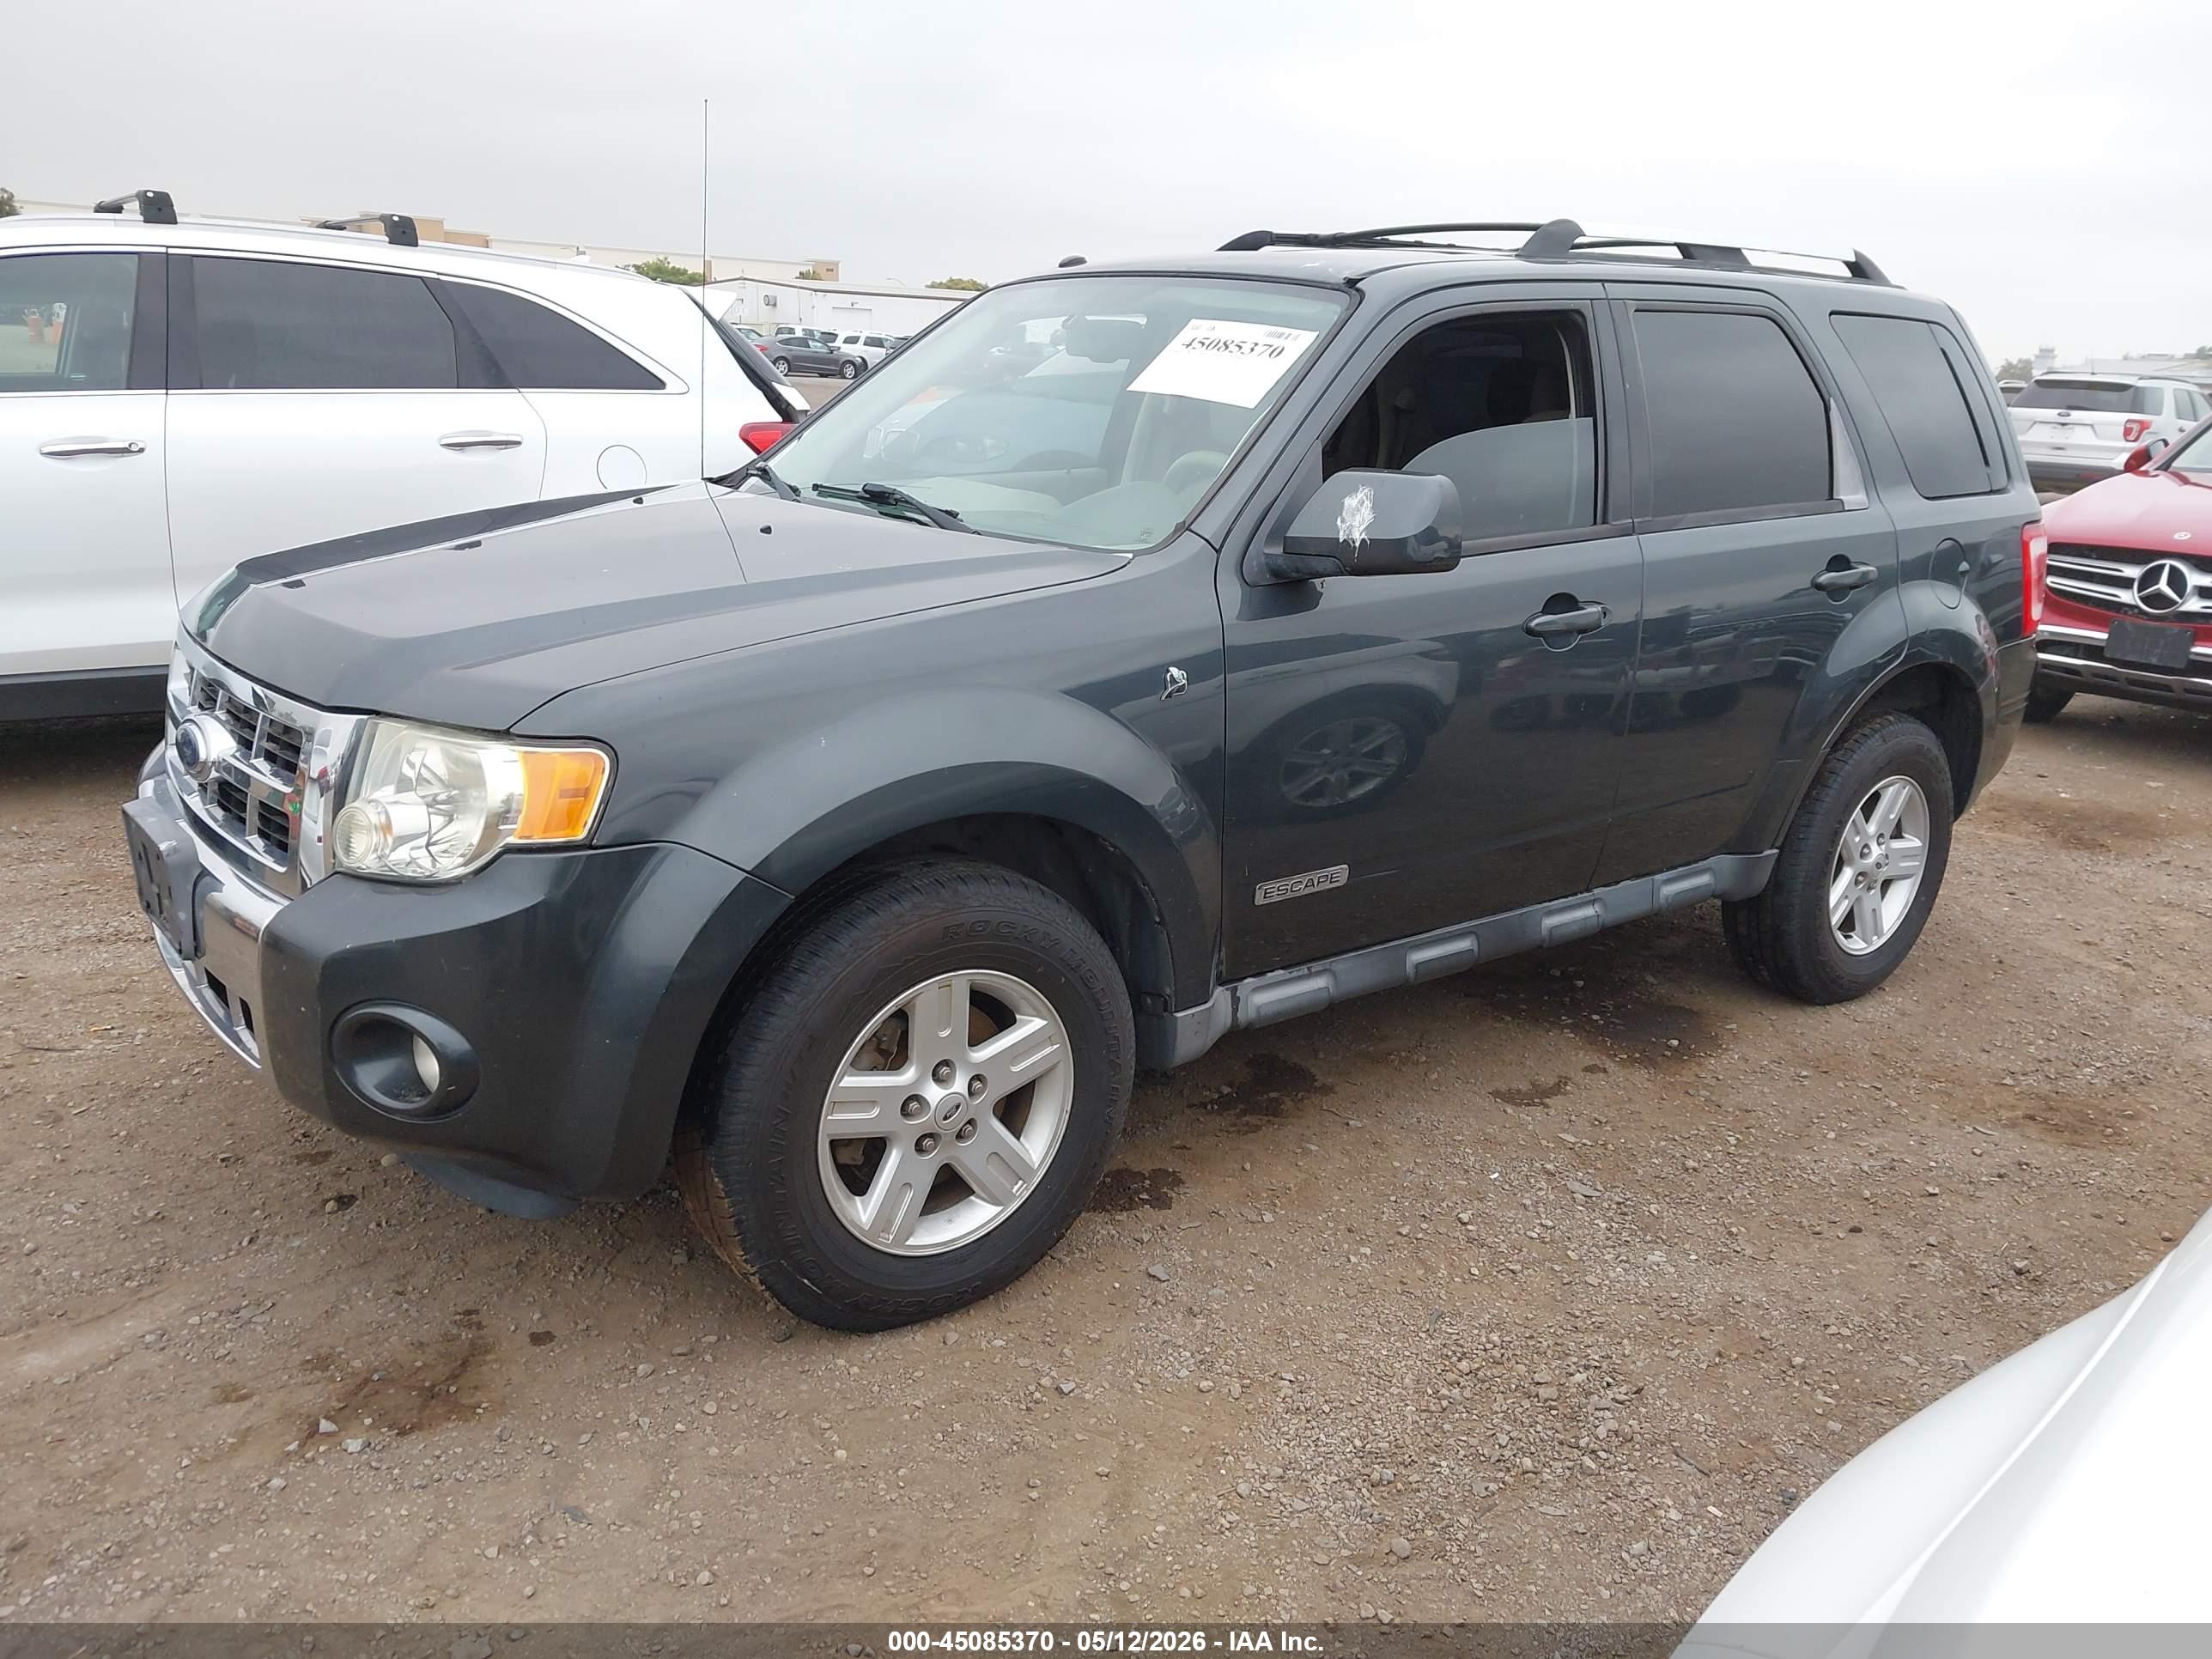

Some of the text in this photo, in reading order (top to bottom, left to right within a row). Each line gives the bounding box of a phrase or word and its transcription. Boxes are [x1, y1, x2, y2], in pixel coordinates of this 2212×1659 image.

[1182, 337, 1285, 358] 45085370
[1262, 869, 1342, 900] ESCAPE
[941, 920, 1059, 949] ROCKY
